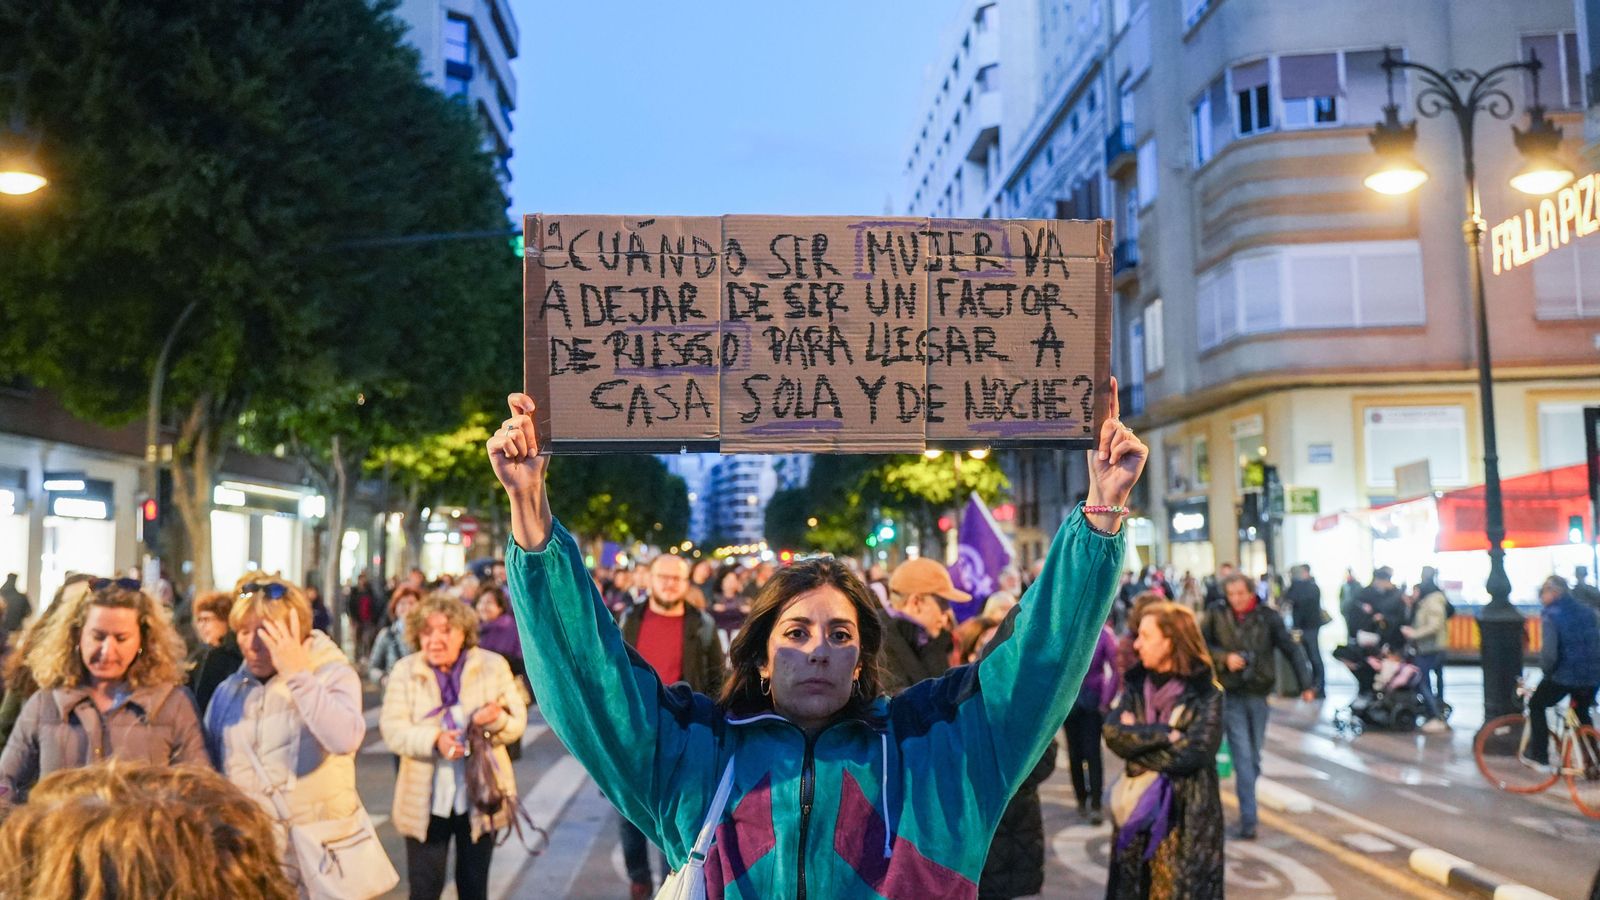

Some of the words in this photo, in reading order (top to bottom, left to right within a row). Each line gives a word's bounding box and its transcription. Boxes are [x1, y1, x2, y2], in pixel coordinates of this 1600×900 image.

[1491, 198, 1559, 275] FALLA
[1558, 172, 1600, 244] PIZ
[767, 233, 843, 279] SER
[866, 230, 1005, 280] MUJER
[1022, 227, 1070, 280] VA
[538, 280, 573, 329] A
[579, 281, 707, 327] DEJAR
[726, 281, 774, 321] DE
[783, 282, 849, 323] SER
[865, 279, 917, 319] UN
[936, 278, 1079, 322] FACTOR
[549, 335, 601, 376] DE
[601, 330, 740, 370] RIESGO
[762, 326, 854, 370] PARA
[865, 321, 1013, 367] LLEGAR
[1029, 320, 1065, 368] A
[589, 378, 712, 428] CASA
[737, 374, 844, 424] SOLA
[855, 374, 887, 425] Y
[895, 381, 946, 424] DE
[964, 374, 1094, 433] NOCHE?
